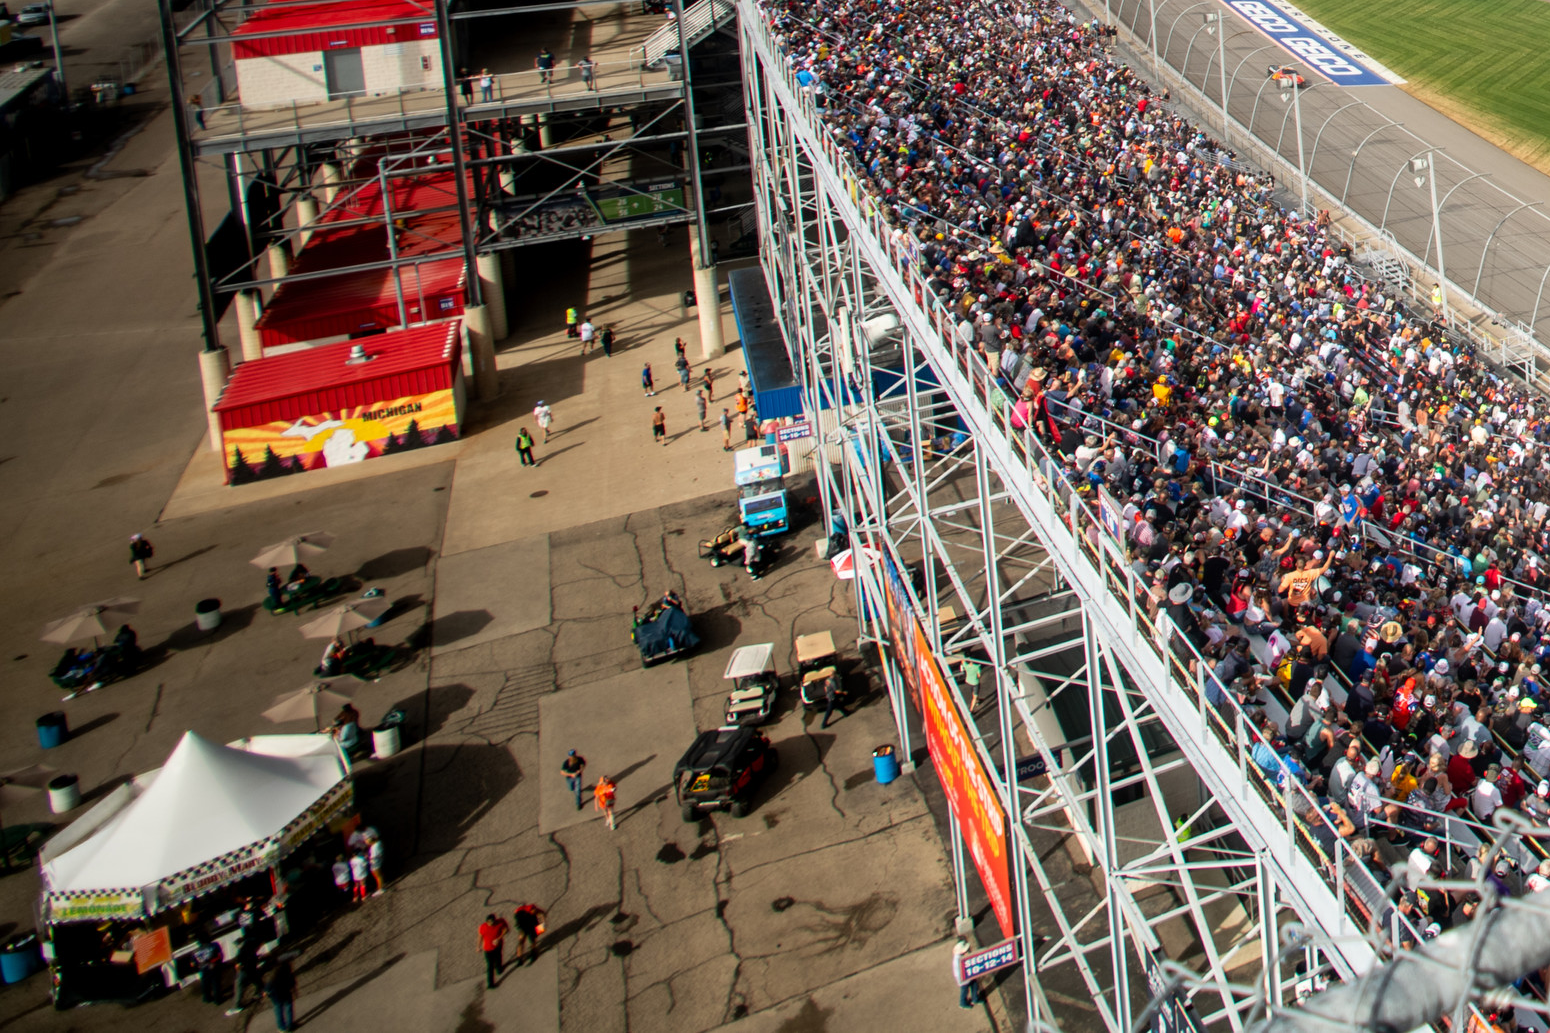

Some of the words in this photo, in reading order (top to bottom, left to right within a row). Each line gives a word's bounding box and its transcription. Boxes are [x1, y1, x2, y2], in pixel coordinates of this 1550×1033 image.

[1230, 1, 1299, 32] GEICO
[1280, 37, 1363, 76] GEICO
[362, 402, 422, 422] MICHIGAN
[947, 710, 959, 745] OF
[958, 734, 978, 789] THE
[976, 773, 1003, 838] STRIP
[979, 803, 1000, 858] TRIP
[964, 942, 1013, 968] SECTIONS
[965, 952, 1013, 976] 10-12-14
